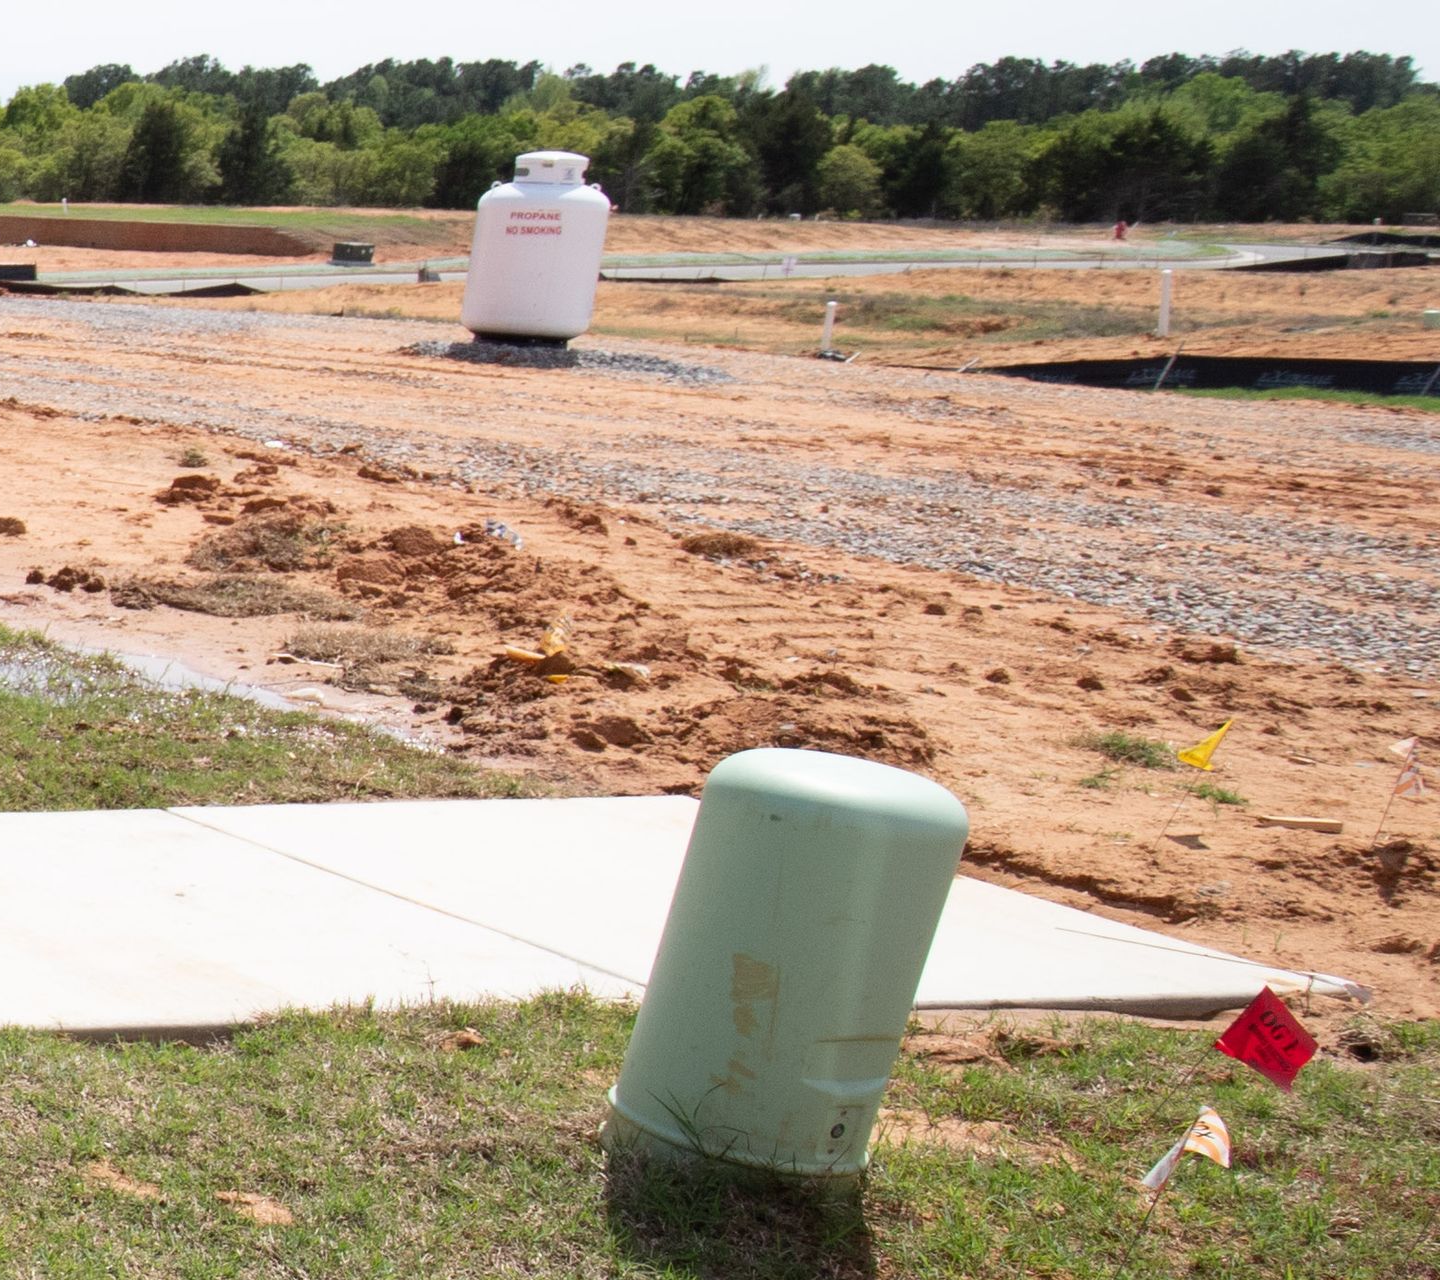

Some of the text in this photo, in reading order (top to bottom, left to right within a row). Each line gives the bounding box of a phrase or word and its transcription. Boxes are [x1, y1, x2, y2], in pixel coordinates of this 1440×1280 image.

[510, 211, 561, 220] PROPANE
[506, 226, 562, 235] NO SMOKING
